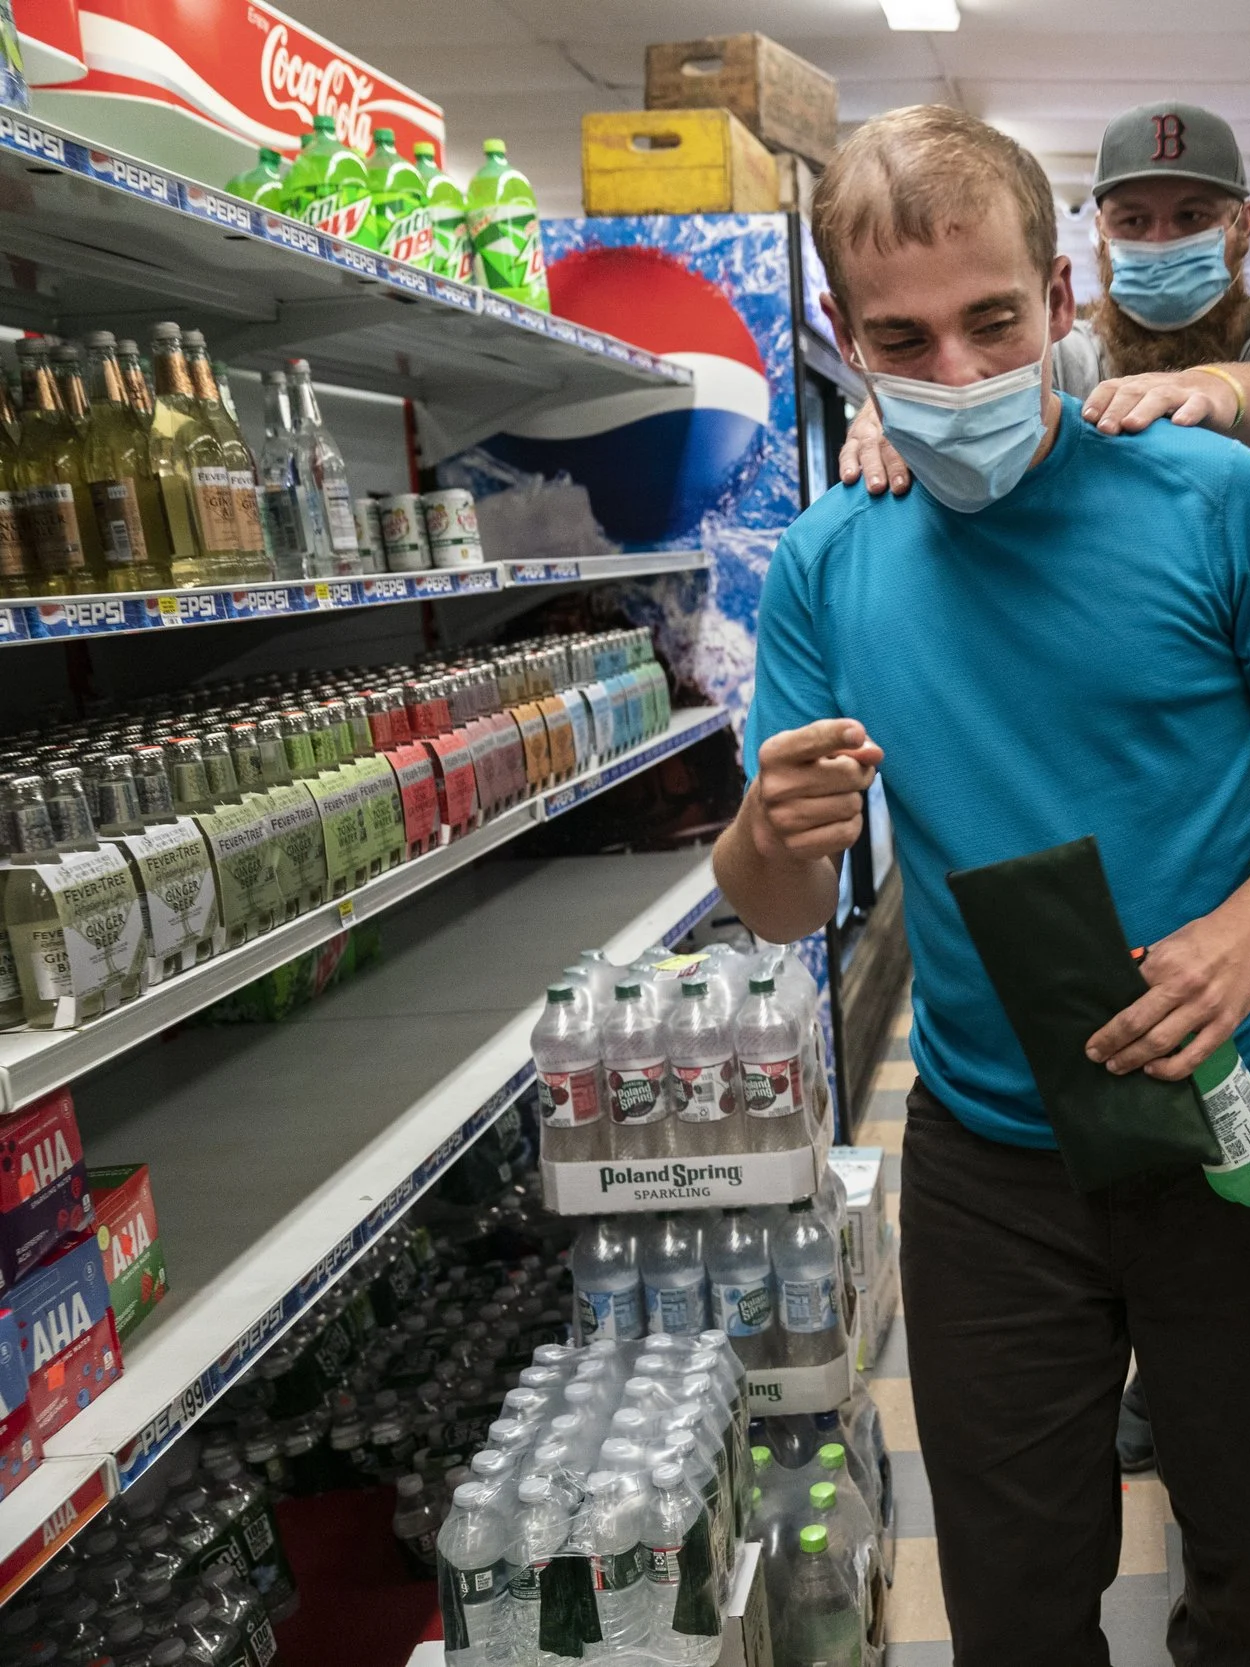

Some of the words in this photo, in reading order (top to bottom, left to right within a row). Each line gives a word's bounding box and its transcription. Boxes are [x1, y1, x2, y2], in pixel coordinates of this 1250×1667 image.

[1, 117, 65, 162] PEPSI
[1152, 114, 1186, 160] B
[113, 158, 168, 200] PEPSI
[205, 197, 251, 231] PEPSI
[282, 225, 320, 255] PEPSI
[345, 249, 377, 275] PEPSI
[325, 582, 353, 602] EPSI
[375, 578, 407, 599] PEPSI
[425, 574, 453, 595] PEPSI
[64, 601, 126, 627] PEPSI
[179, 595, 217, 620] EPSI
[248, 589, 289, 612] PEPSI
[271, 806, 316, 831] FEVER-TREE
[219, 826, 264, 852] FEVER-TREE
[146, 842, 201, 872] FEVER-TREE
[63, 872, 127, 905] FEVER-TREE
[165, 880, 200, 904] GINGER
[86, 913, 126, 939] GINGER
[95, 930, 120, 951] BEER
[20, 1129, 73, 1202] AHA
[600, 1164, 670, 1193] Poland
[672, 1163, 742, 1187] Spring
[381, 1174, 412, 1218] PEPSI
[634, 1187, 711, 1200] SPARKLING
[111, 1212, 151, 1280] AHA
[317, 1234, 356, 1285] PEPSI
[33, 1291, 93, 1372] AHA
[239, 1299, 285, 1359] PEPSI
[749, 1381, 783, 1400] ing
[42, 1499, 79, 1549] AHA
